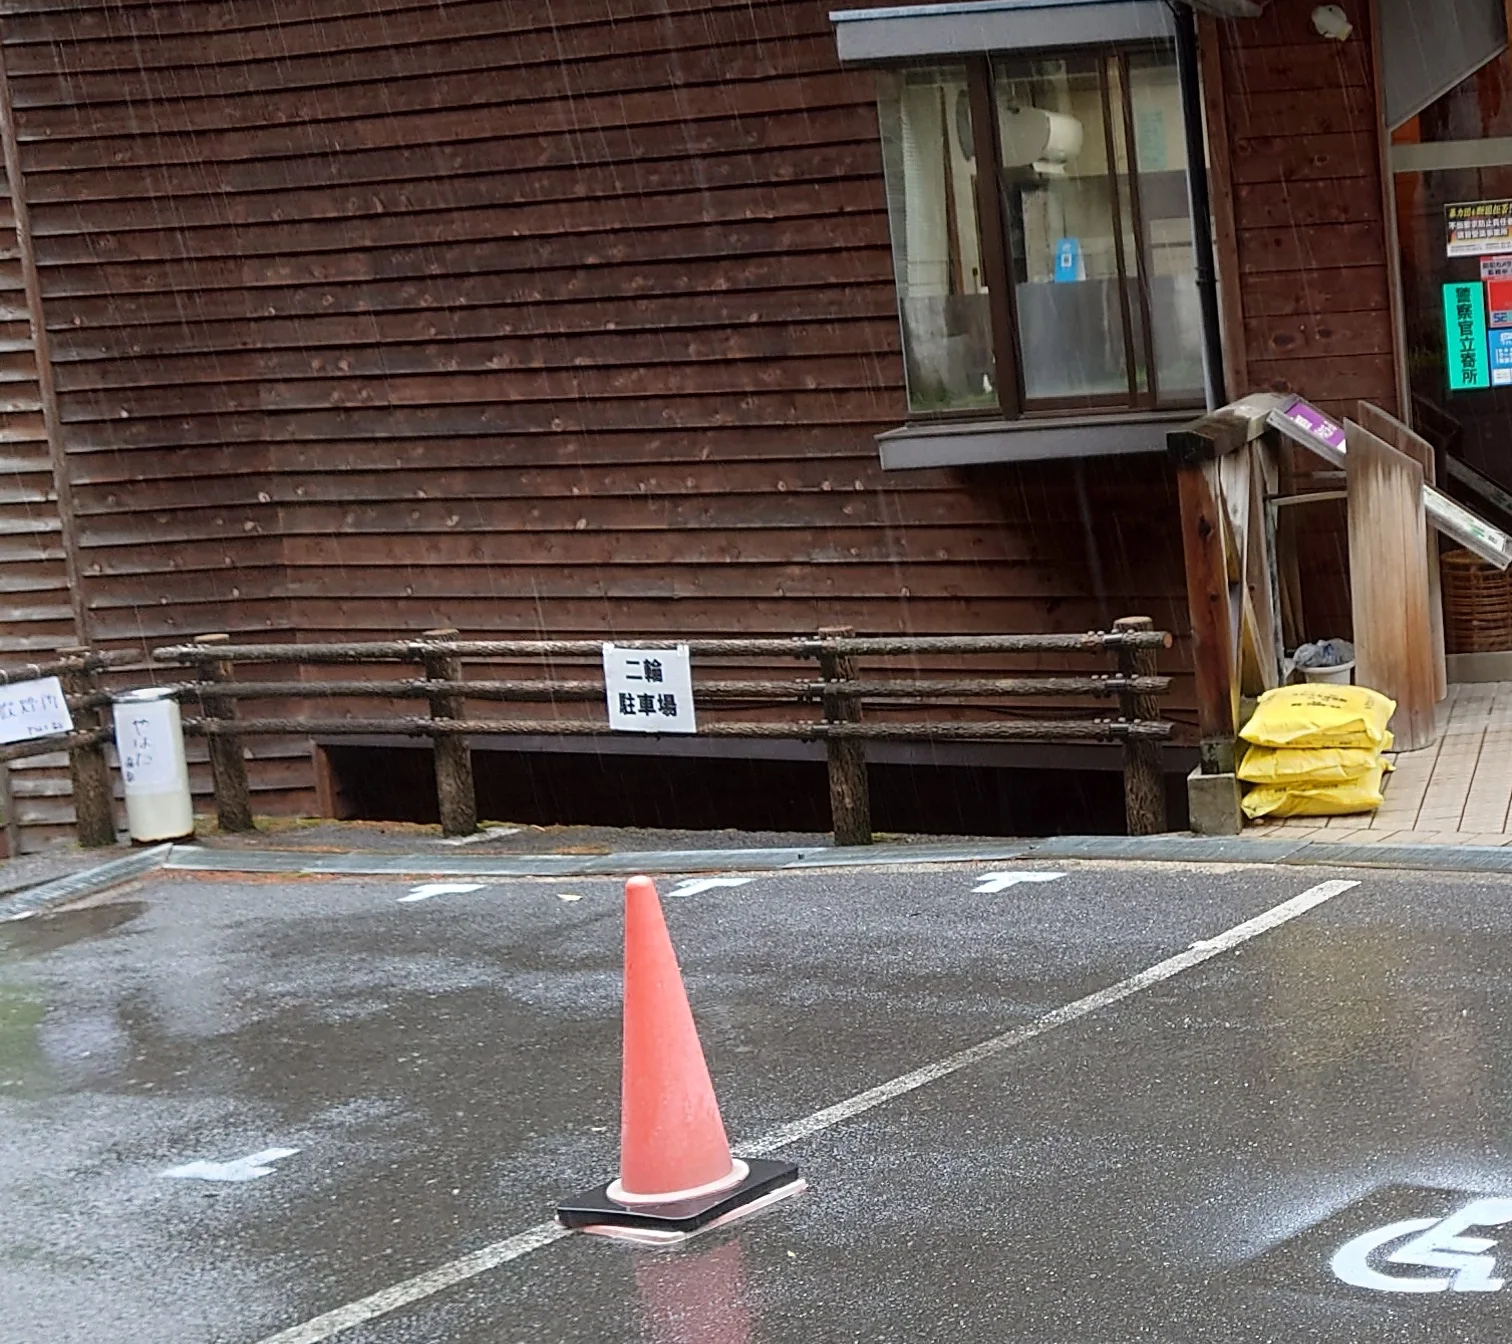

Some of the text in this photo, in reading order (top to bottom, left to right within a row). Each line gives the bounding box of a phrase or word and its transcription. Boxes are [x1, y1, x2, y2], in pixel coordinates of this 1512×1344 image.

[1456, 287, 1477, 384] 警察官立寄所
[626, 658, 663, 683] 二輪
[619, 692, 677, 716] 駐車場
